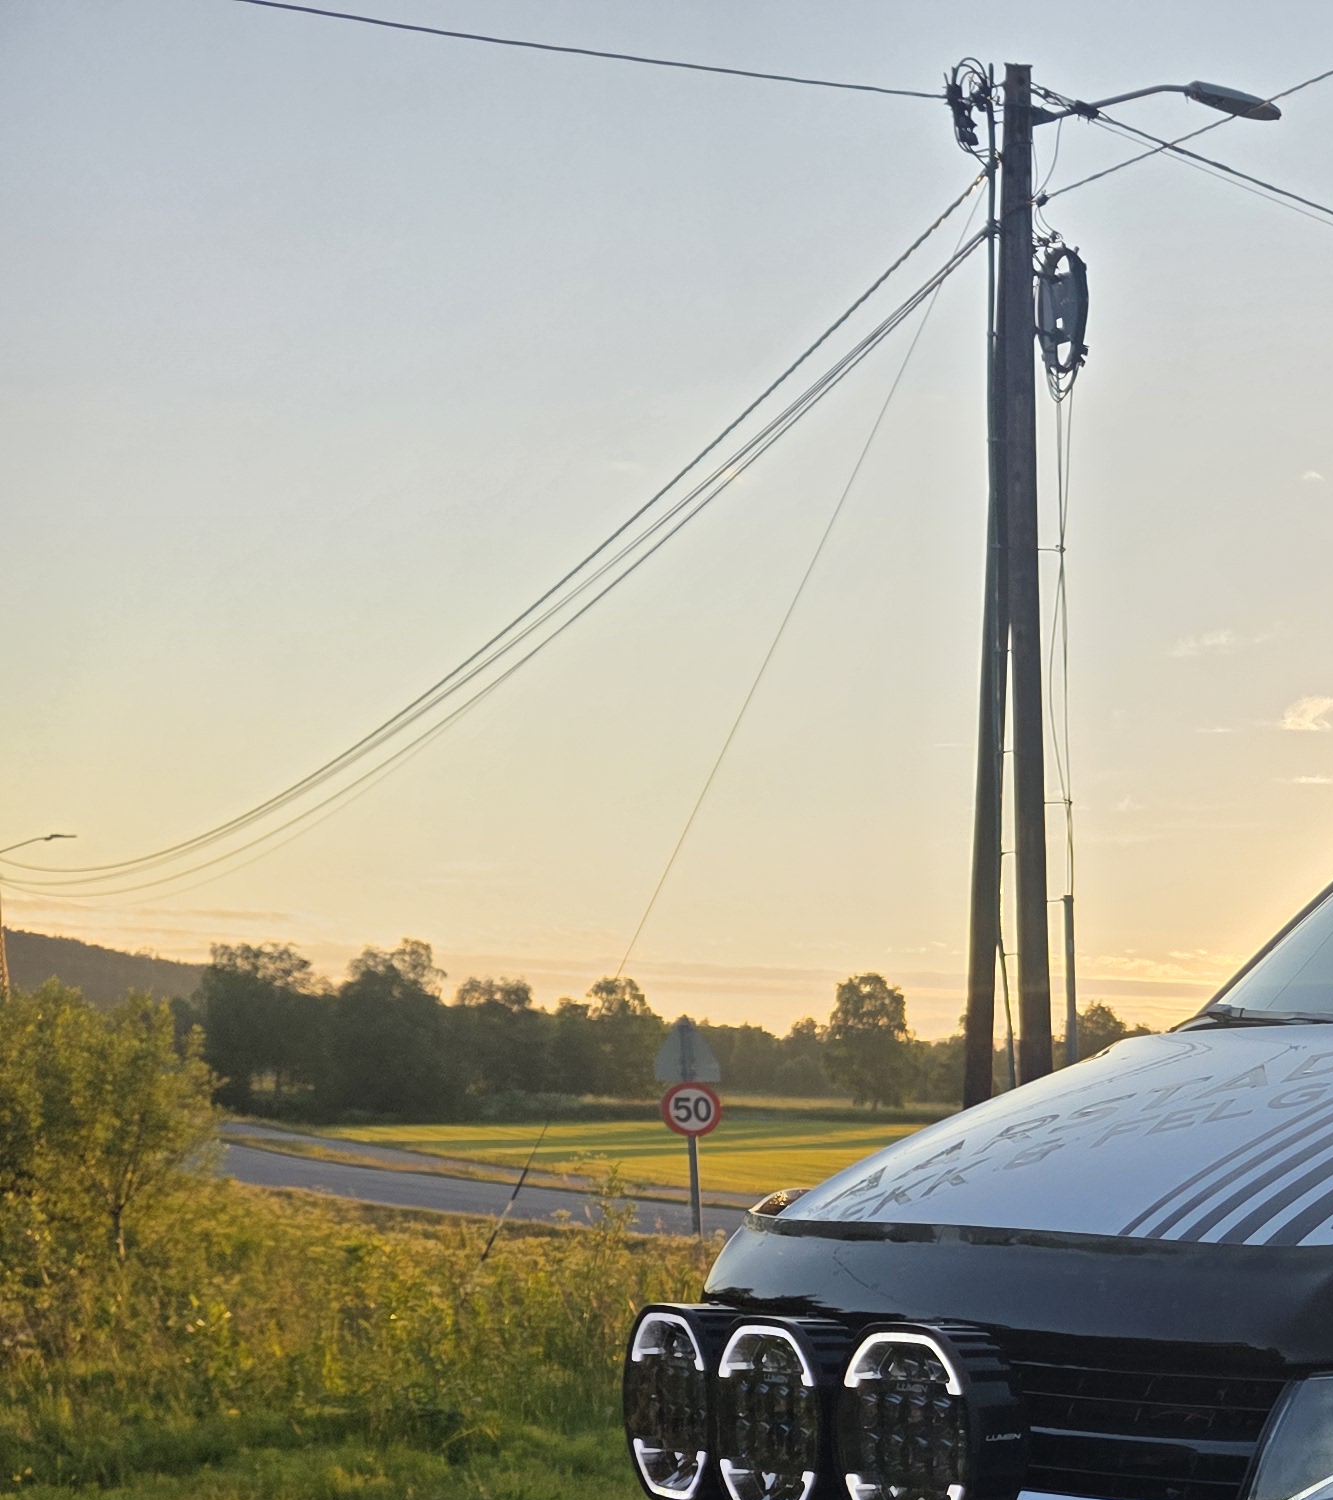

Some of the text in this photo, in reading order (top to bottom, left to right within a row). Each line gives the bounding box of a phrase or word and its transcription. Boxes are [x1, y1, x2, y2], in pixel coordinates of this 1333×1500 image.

[673, 1097, 712, 1123] 50
[1091, 1082, 1330, 1149] FELG
[896, 1382, 928, 1394] LUMEN
